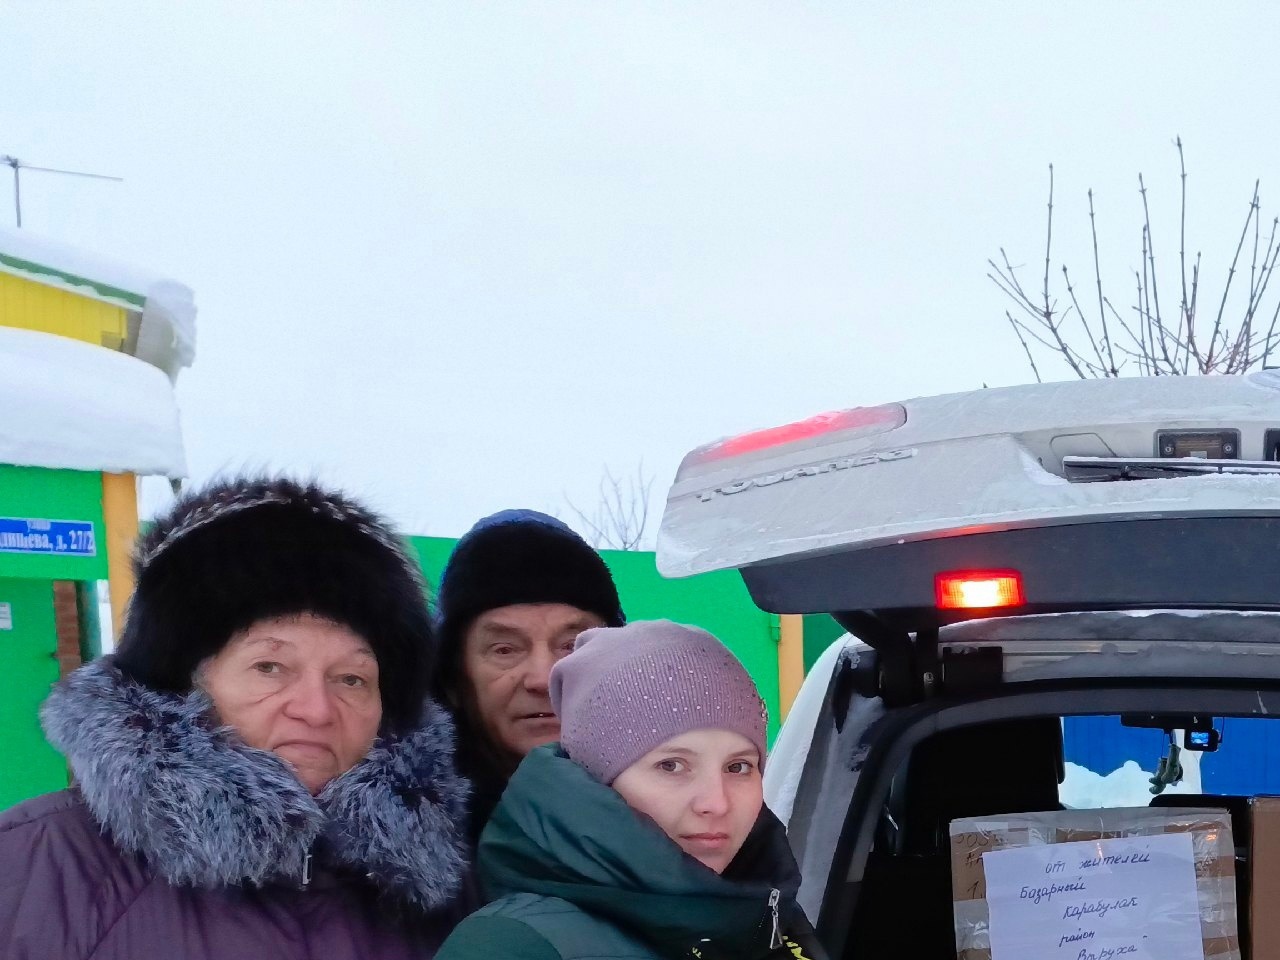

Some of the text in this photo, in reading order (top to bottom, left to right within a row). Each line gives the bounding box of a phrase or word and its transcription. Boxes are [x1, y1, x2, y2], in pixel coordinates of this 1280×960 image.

[1078, 844, 1150, 869] жителей
[1019, 876, 1086, 905] Базарный
[1062, 896, 1138, 920] Карабулак
